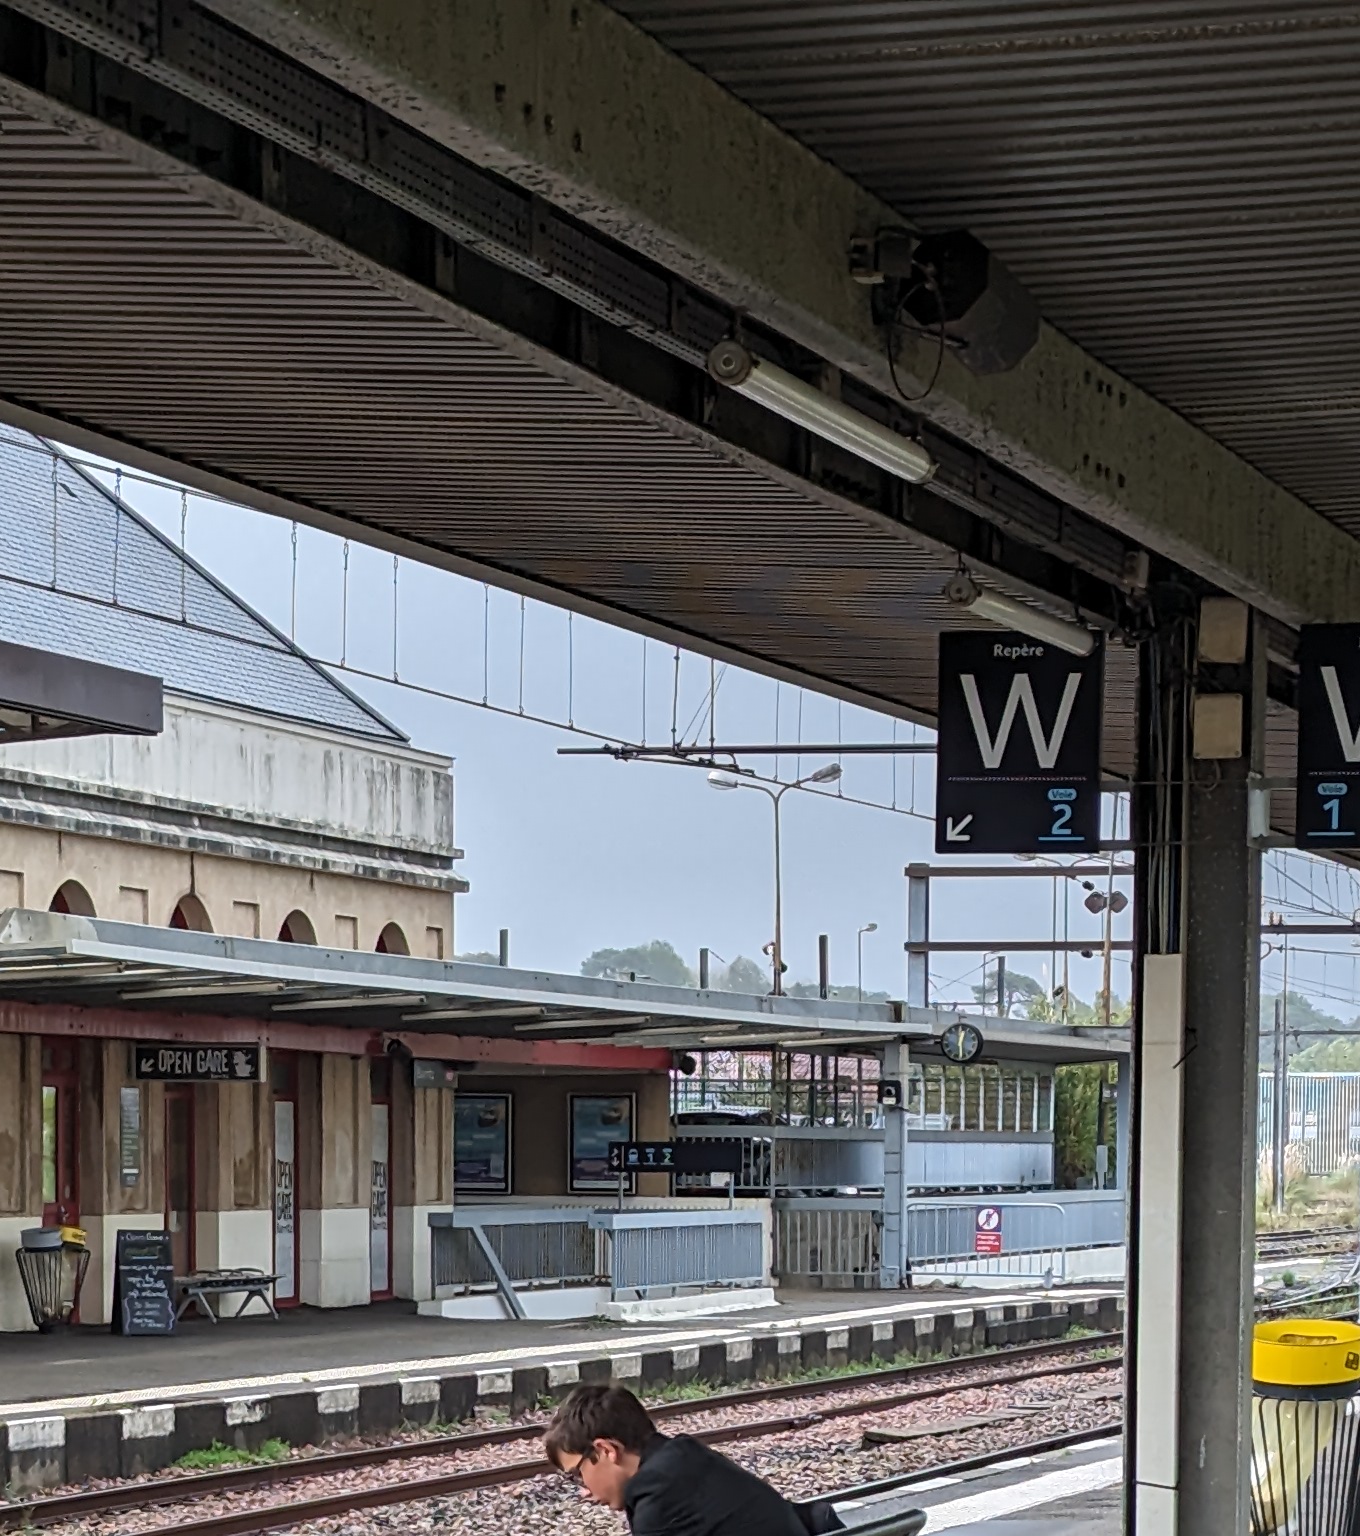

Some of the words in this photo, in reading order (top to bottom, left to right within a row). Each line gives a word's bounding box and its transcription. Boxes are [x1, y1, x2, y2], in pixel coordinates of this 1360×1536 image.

[993, 643, 1044, 660] Repère
[959, 672, 1083, 769] W
[1051, 803, 1072, 835] 2
[1322, 799, 1340, 830] 1
[158, 1048, 193, 1075] OPEN
[196, 1048, 230, 1074] GARE
